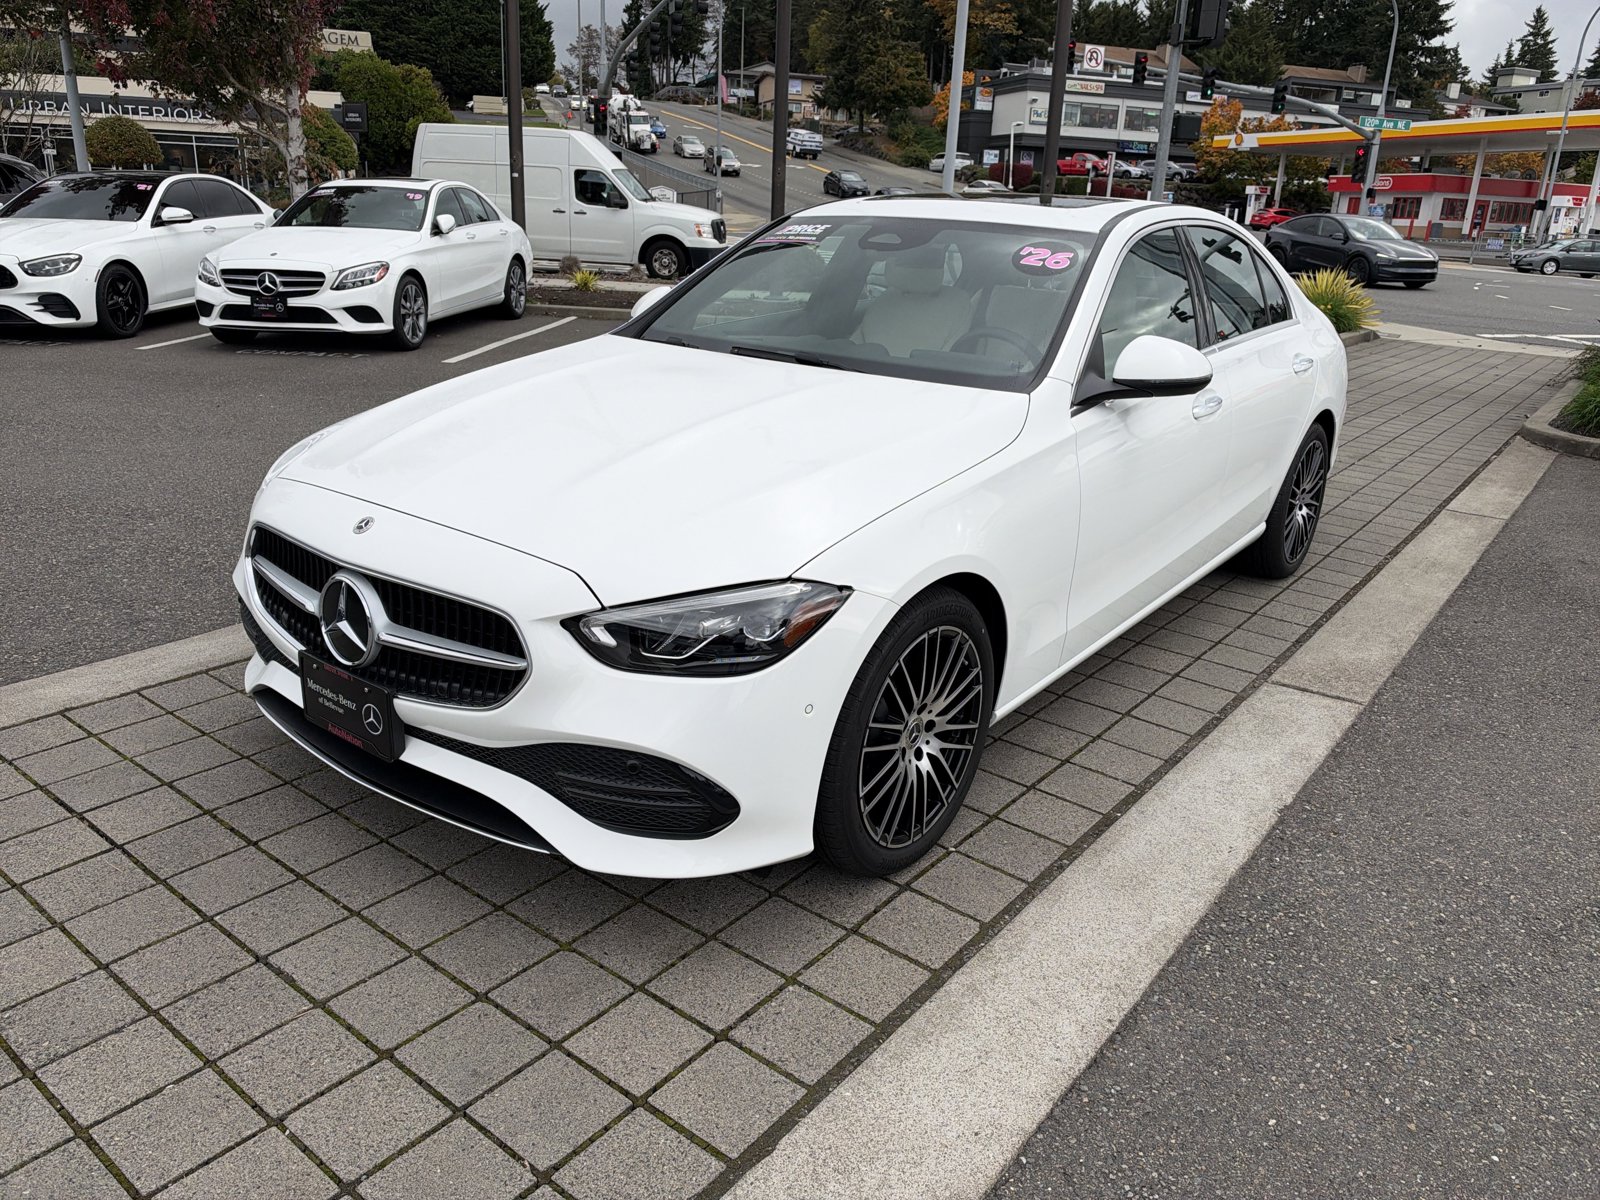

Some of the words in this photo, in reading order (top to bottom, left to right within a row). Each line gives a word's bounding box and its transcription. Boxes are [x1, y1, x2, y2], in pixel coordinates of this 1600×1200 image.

[100, 101, 217, 124] INTERIORS
[1365, 118, 1379, 128] 120th
[1382, 120, 1394, 129] Ave
[1397, 121, 1406, 130] NE
[306, 677, 357, 711] Mercedes-Benz
[327, 723, 364, 748] AutoNation
